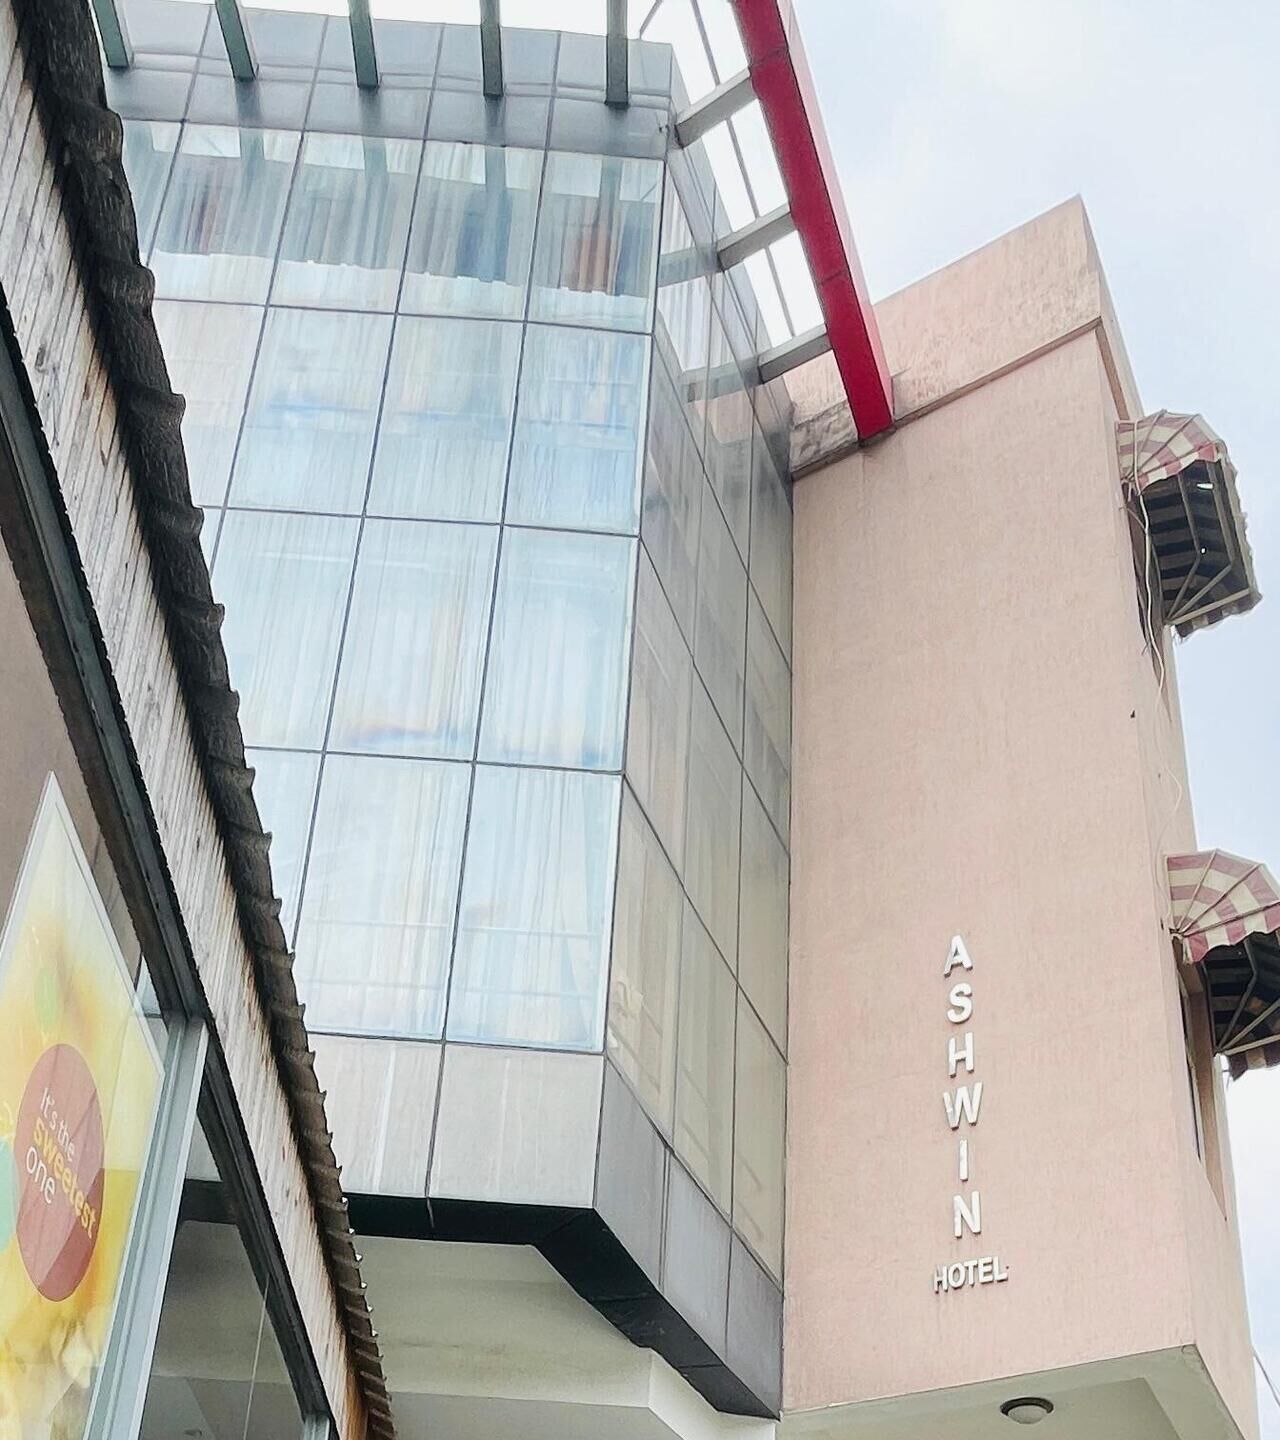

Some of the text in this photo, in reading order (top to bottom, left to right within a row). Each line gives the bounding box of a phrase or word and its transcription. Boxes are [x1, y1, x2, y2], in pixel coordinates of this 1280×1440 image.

[57, 1119, 75, 1162] the
[942, 934, 983, 1239] ASHWIN
[33, 1116, 97, 1239] sweetest
